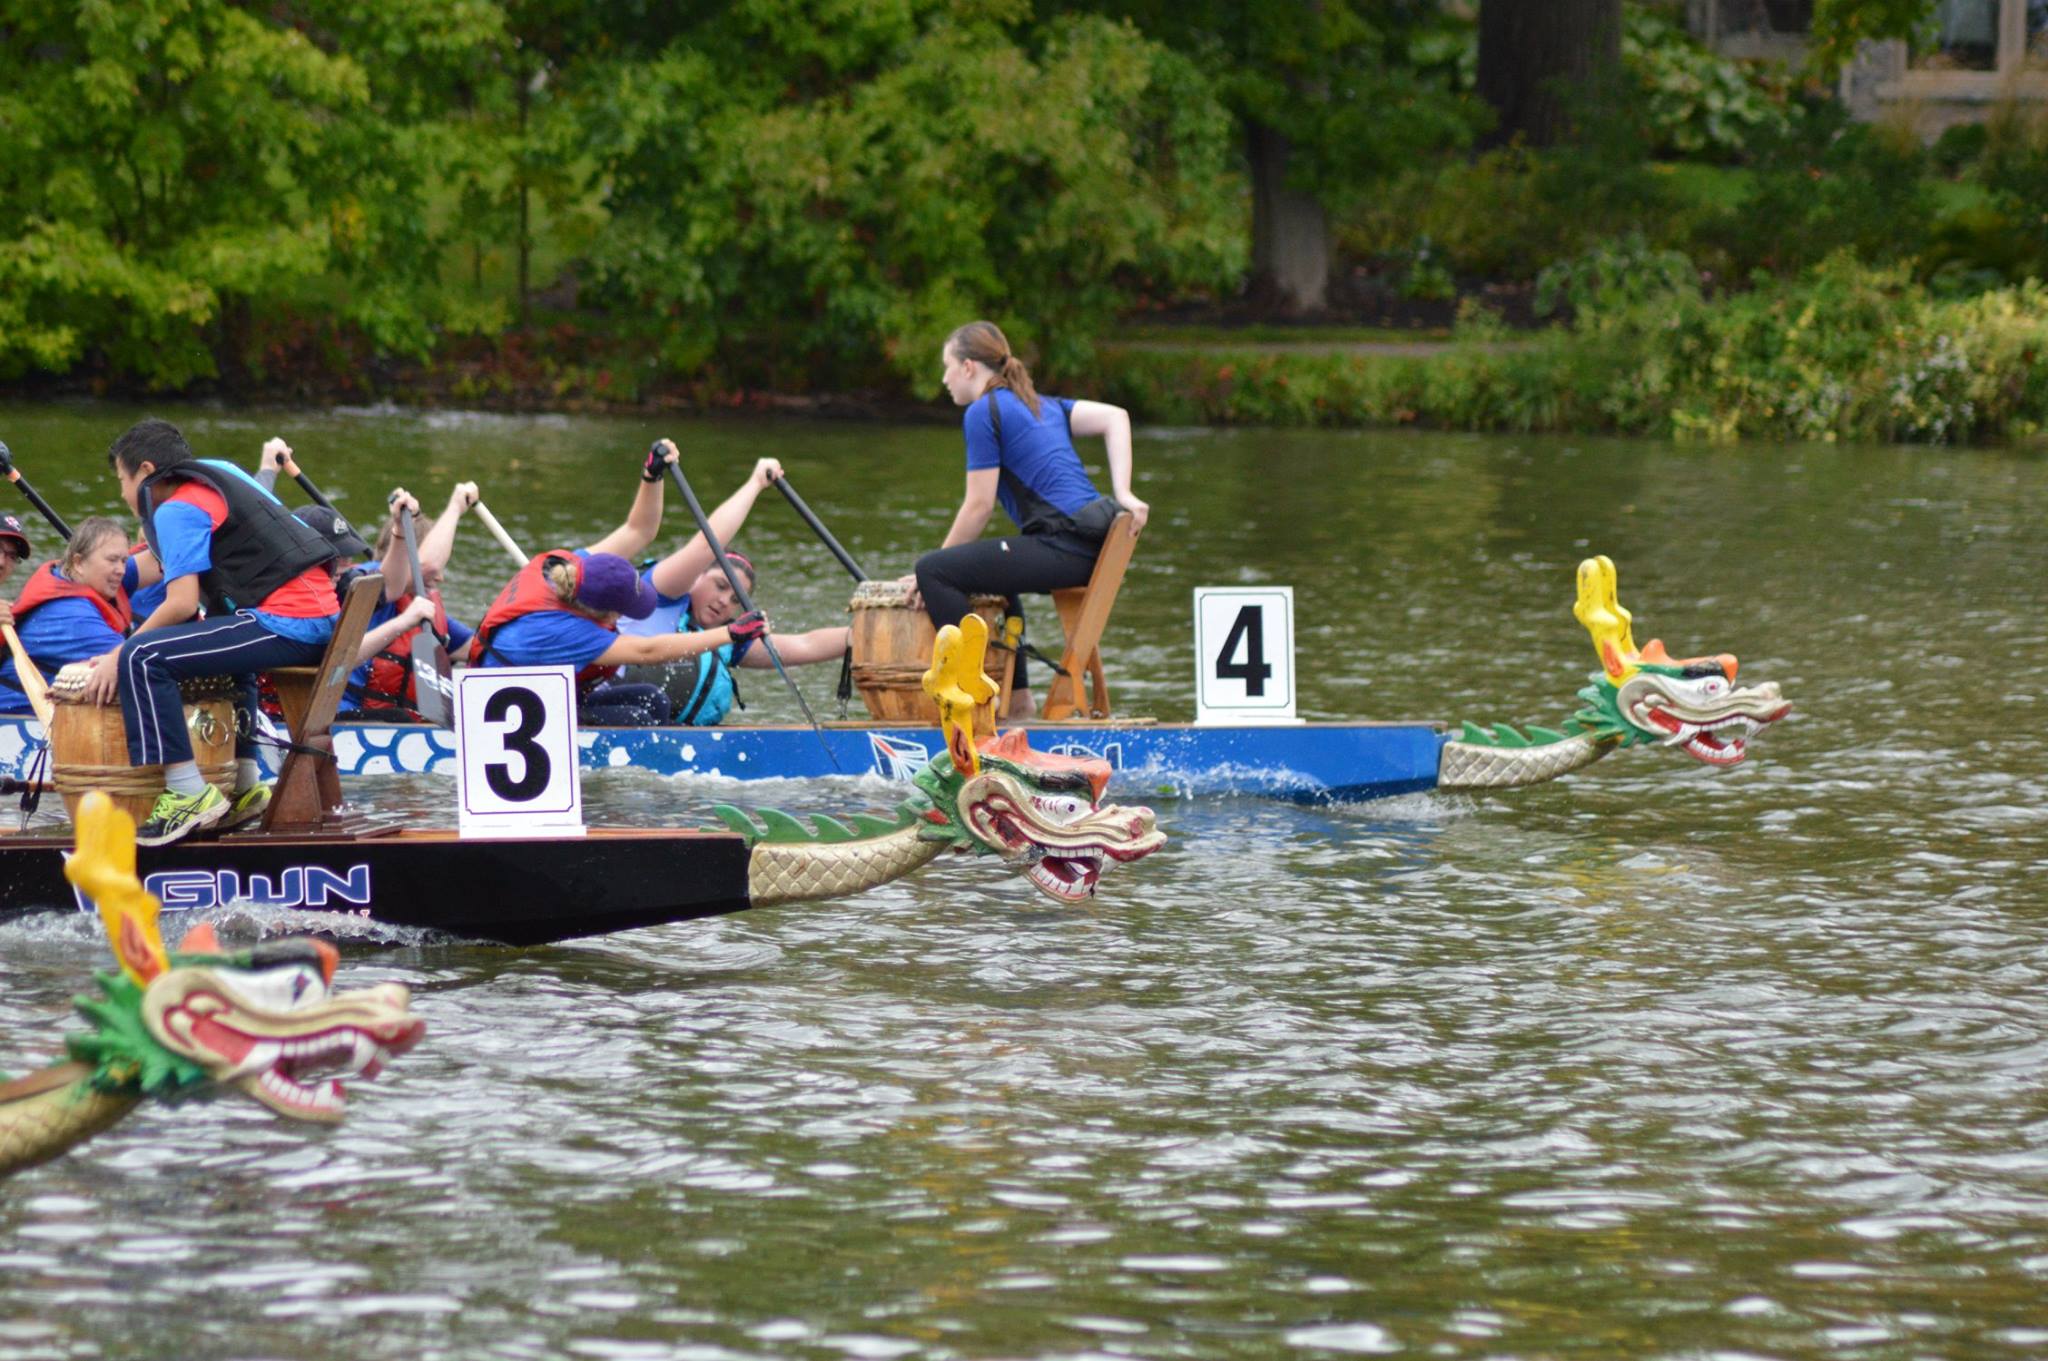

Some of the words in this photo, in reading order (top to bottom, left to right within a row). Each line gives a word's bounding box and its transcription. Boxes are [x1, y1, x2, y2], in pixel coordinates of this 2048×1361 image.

[1216, 605, 1271, 697] 4
[484, 686, 551, 802] 3
[144, 864, 370, 910] GWN
